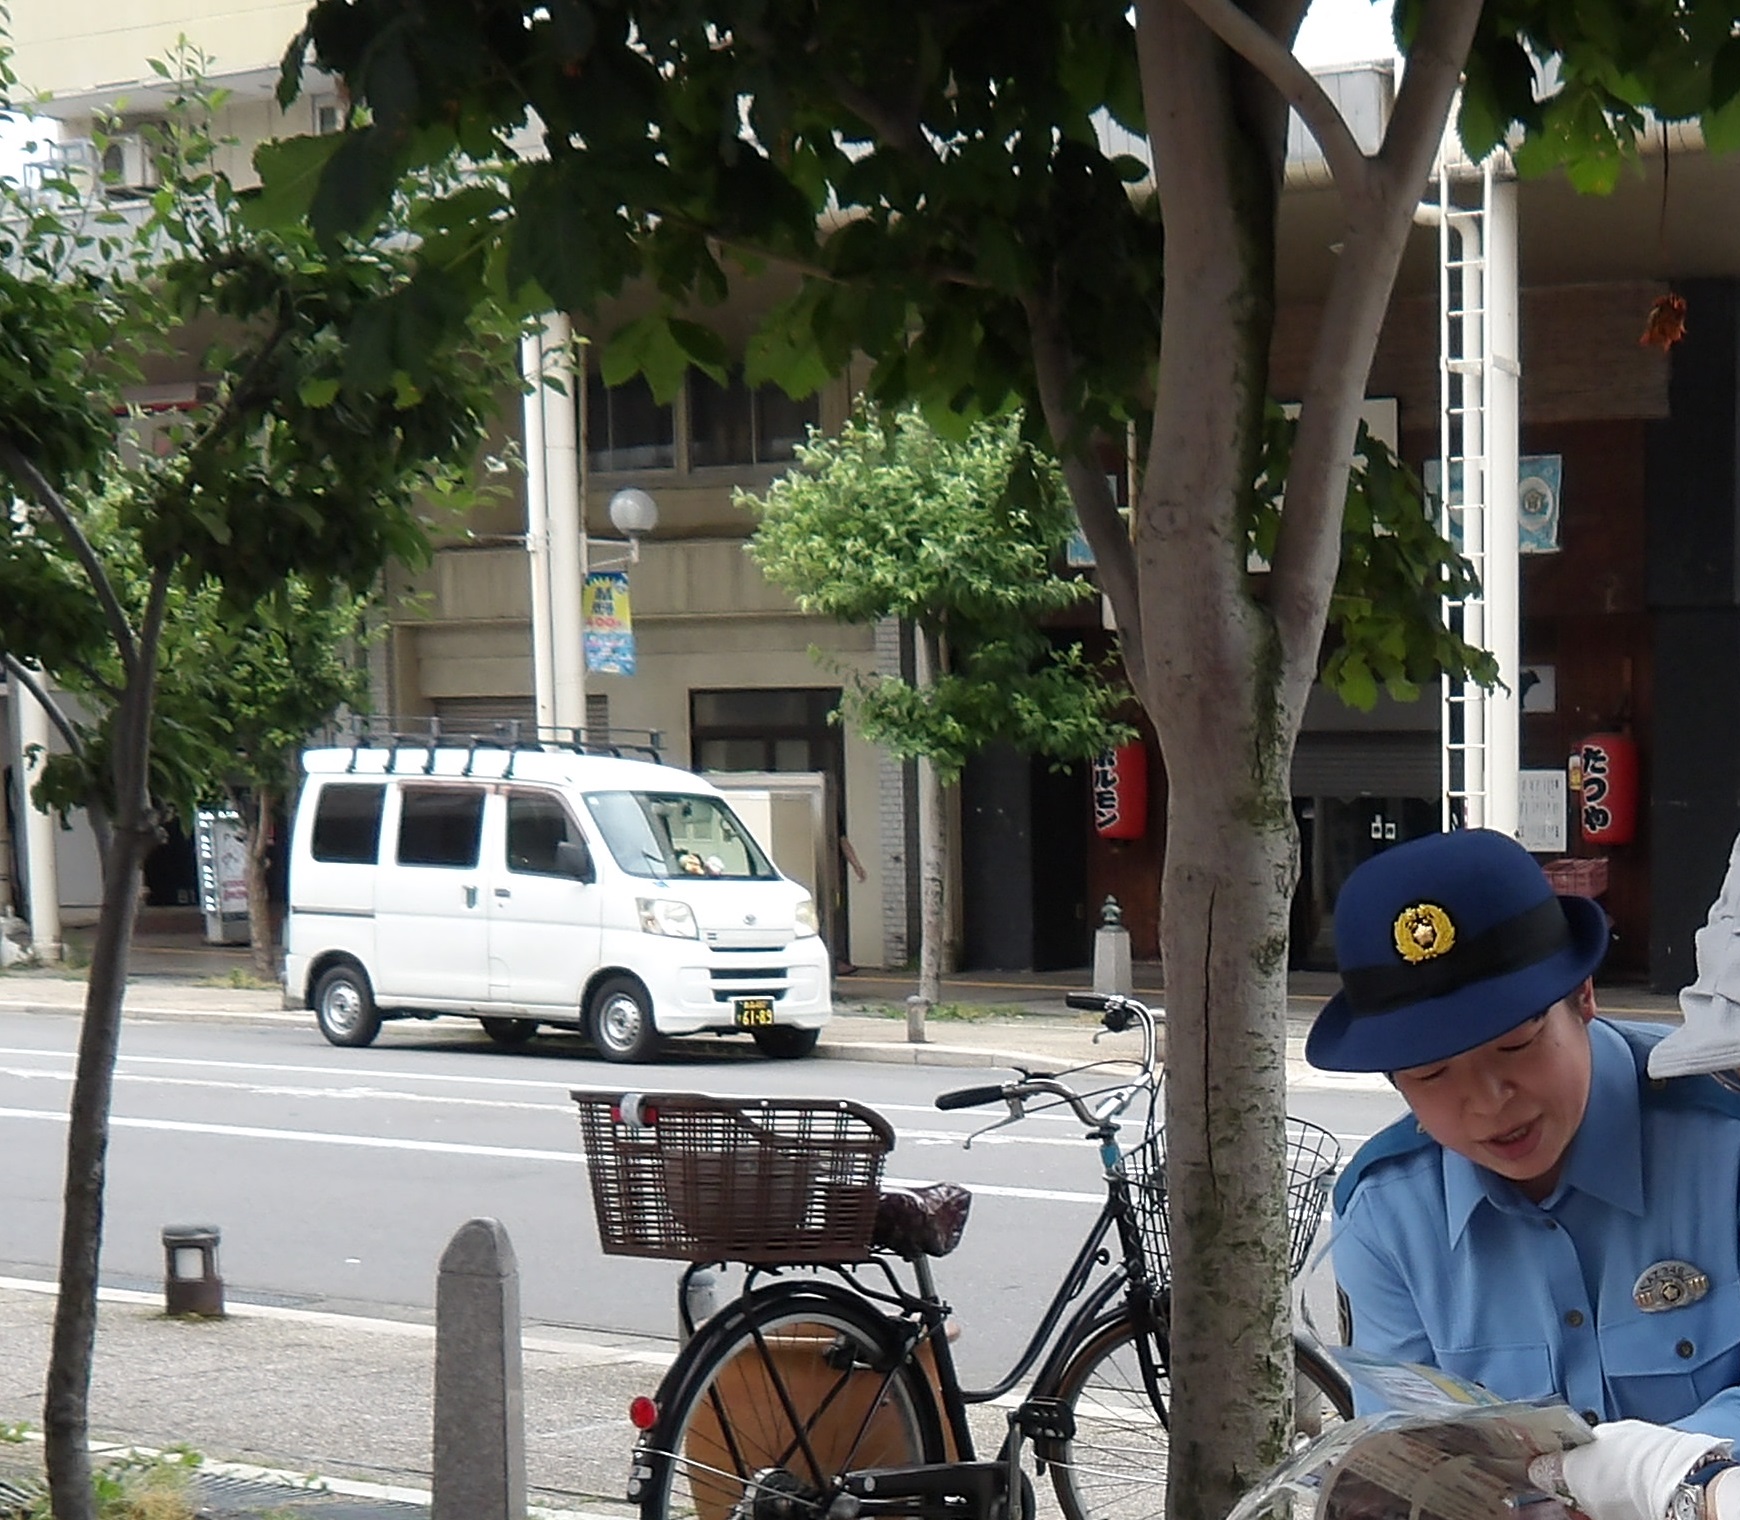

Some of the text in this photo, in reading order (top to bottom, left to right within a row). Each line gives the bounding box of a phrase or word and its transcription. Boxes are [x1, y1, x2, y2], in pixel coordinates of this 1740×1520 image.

[1582, 745, 1611, 834] たつや
[742, 1009, 773, 1026] 61-89
